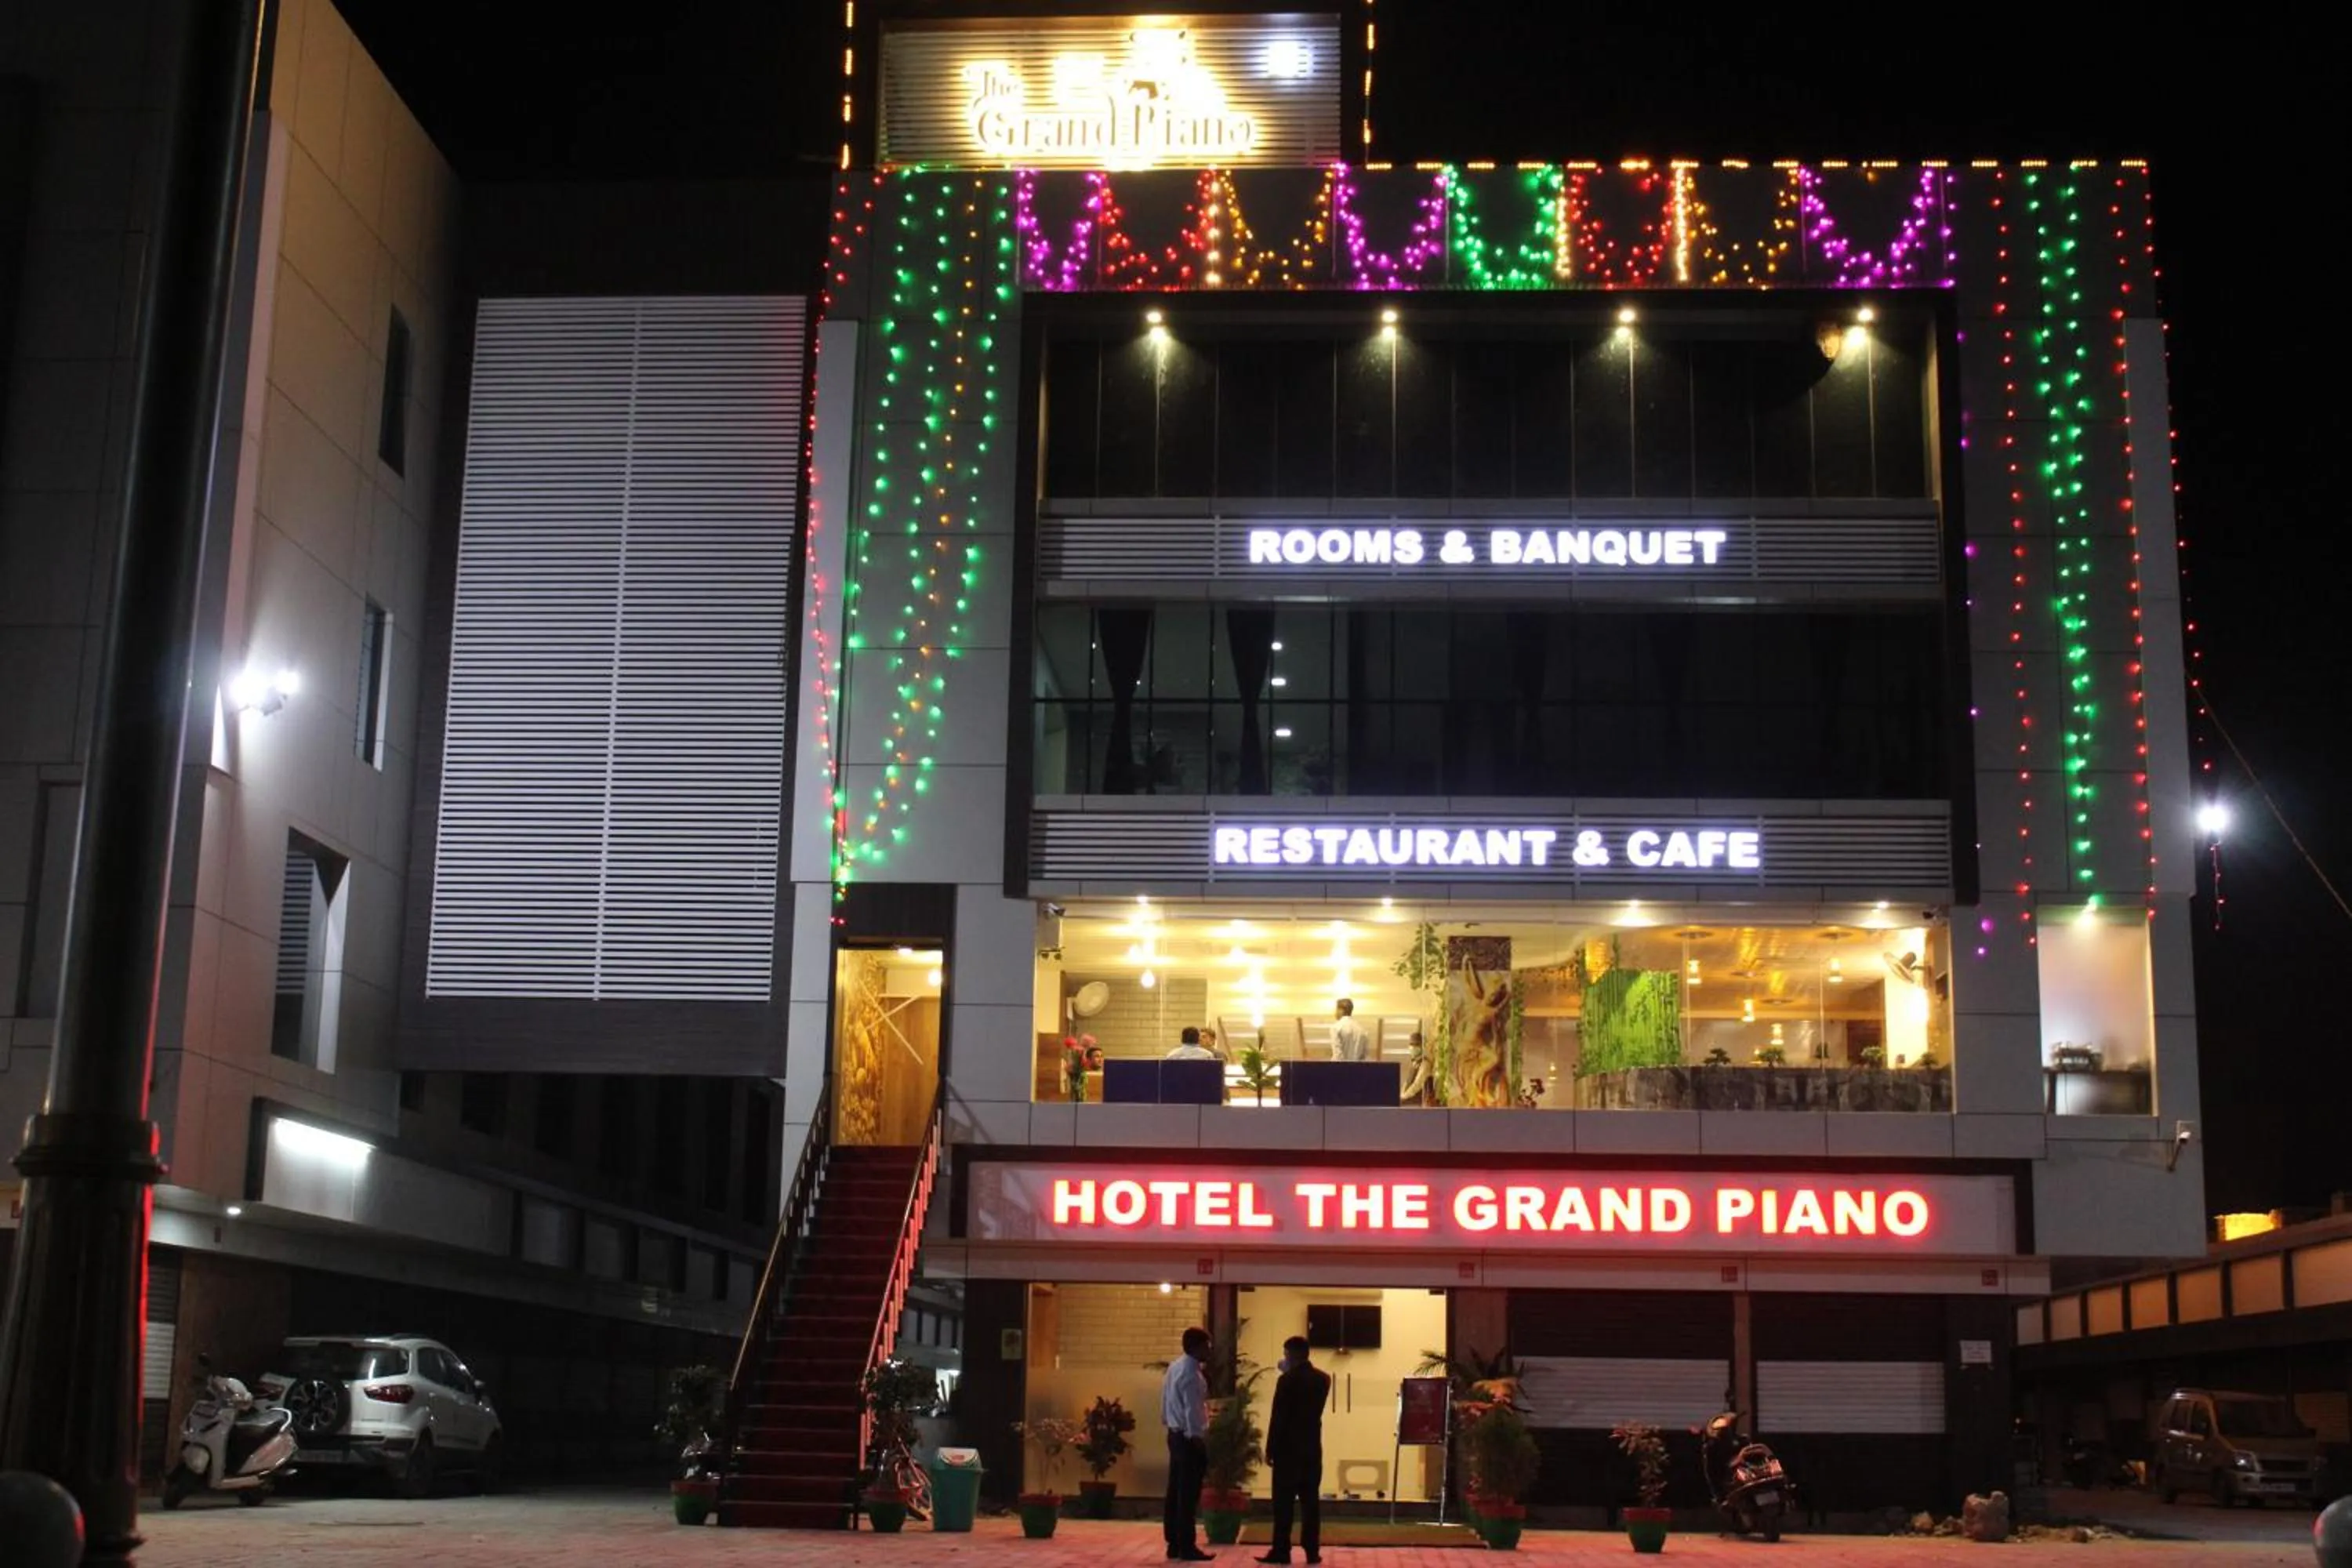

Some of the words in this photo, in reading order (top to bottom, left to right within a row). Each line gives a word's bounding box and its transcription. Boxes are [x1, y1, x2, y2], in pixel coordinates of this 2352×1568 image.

[976, 93, 1116, 151] Grand
[1131, 102, 1252, 150] Piano
[1249, 528, 1425, 565] ROOMS
[1439, 529, 1475, 565] &
[1490, 529, 1727, 566] BANQUET
[1214, 826, 1557, 867] RESTAURANT
[1571, 829, 1610, 867] &
[1626, 829, 1761, 869] CAFE
[1053, 1179, 1274, 1228] HOTEL
[1294, 1182, 1430, 1229] THE
[1453, 1185, 1692, 1233] GRAND
[1716, 1188, 1929, 1237] PIANO
